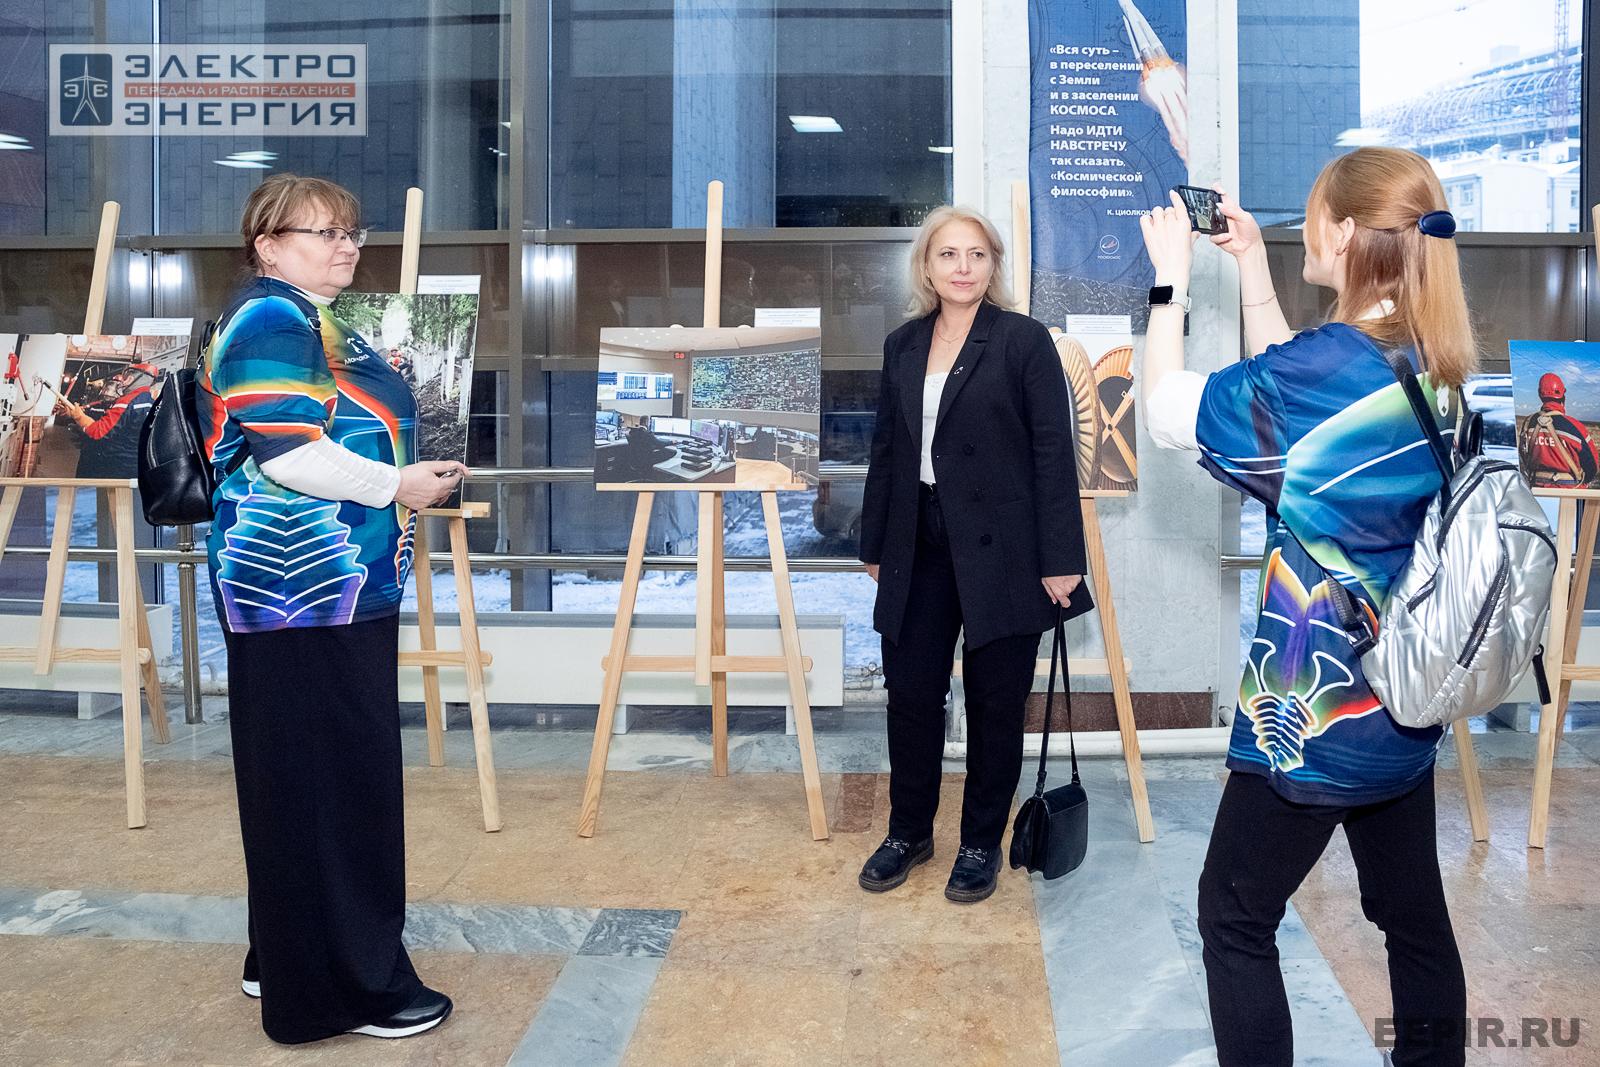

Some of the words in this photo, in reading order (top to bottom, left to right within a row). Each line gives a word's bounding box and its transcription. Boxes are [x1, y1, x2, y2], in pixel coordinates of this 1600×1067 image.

[1050, 44, 1079, 55] «Вся
[1081, 46, 1110, 57] суть
[1050, 61, 1058, 70] в
[1060, 61, 1144, 72] переселении
[1050, 76, 1057, 85] с
[1059, 74, 1100, 85] Земли
[1050, 91, 1059, 100] и
[1061, 91, 1069, 100] в
[1071, 92, 1139, 101] заселении
[1050, 105, 1119, 116] КОСМОСА.
[1050, 125, 1084, 137] Надо
[1086, 125, 1122, 137] ИДТИ
[1050, 158, 1072, 166] так
[1050, 170, 1143, 182] «Космической
[1115, 209, 1151, 217] ЦИОЛКОВ
